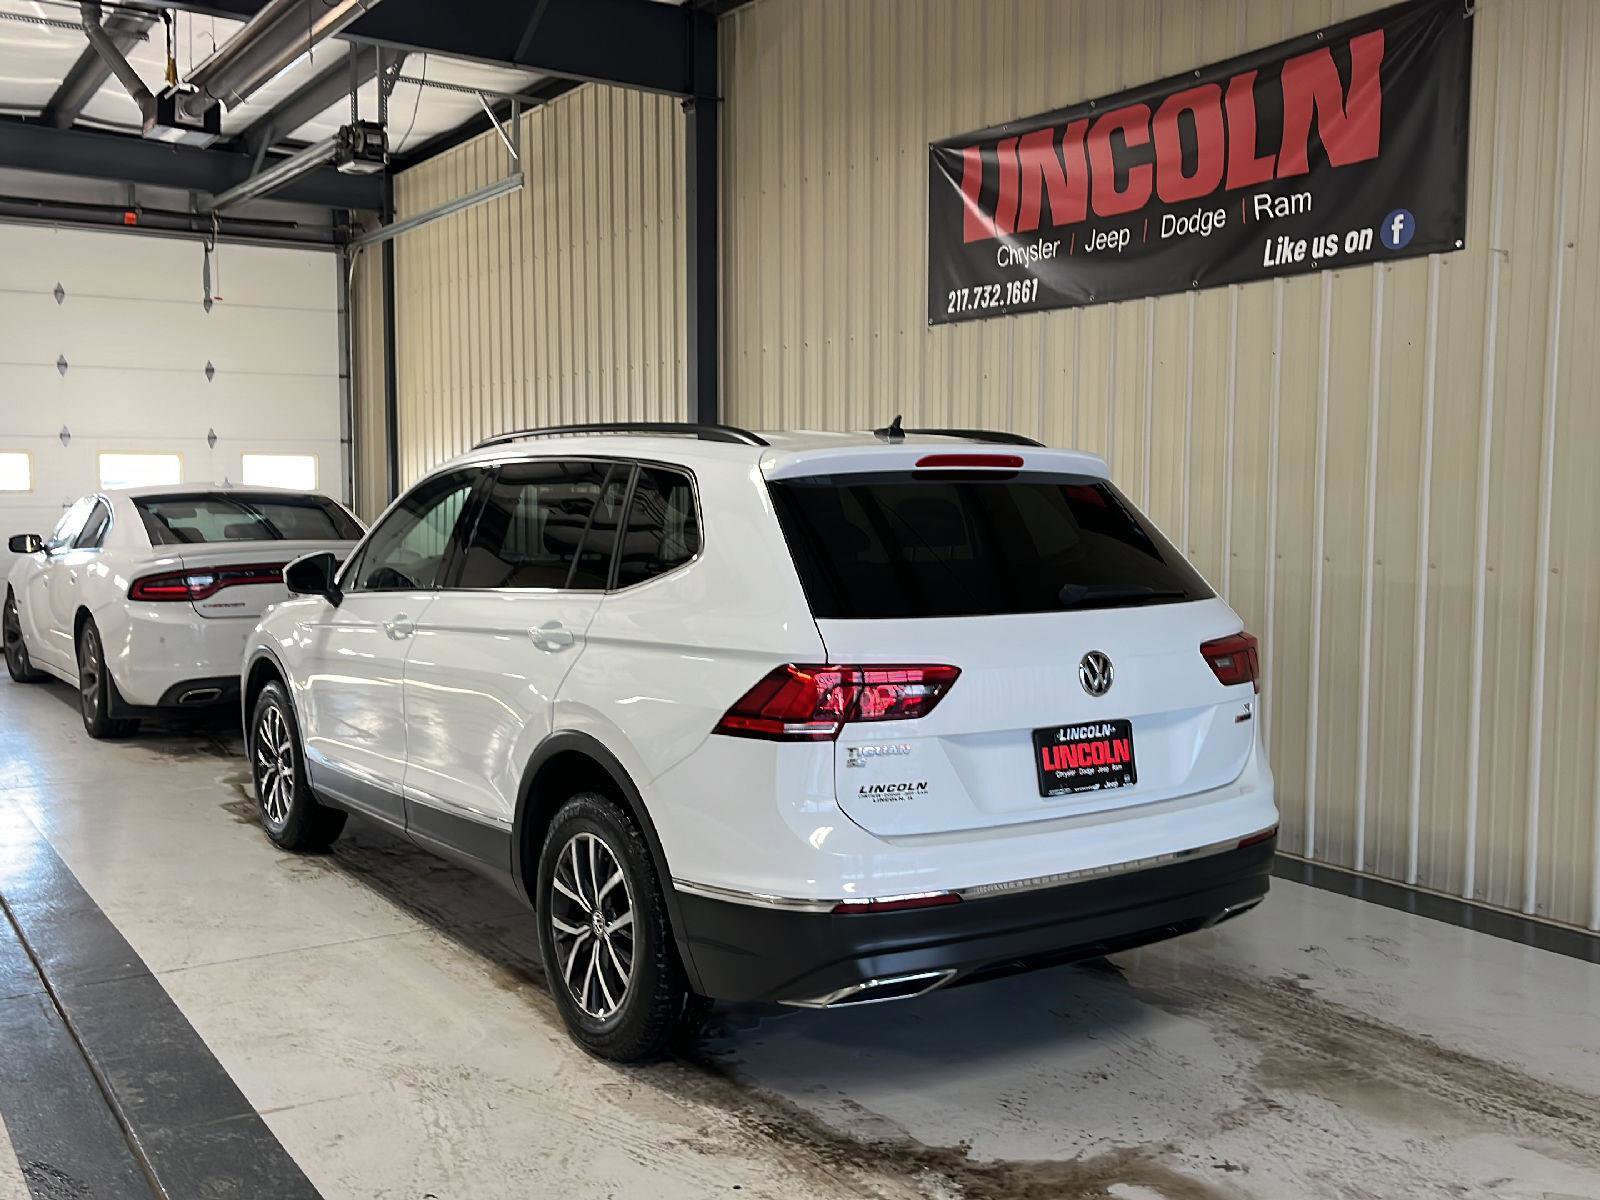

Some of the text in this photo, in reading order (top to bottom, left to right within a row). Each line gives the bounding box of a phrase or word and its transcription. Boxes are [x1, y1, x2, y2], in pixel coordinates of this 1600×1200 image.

[963, 29, 1384, 243] LINCOLN
[997, 191, 1312, 268] Chrysler Jeep Dodge Ram
[1263, 236, 1307, 267] Like
[1312, 234, 1338, 260] us
[1344, 227, 1373, 254] on
[948, 277, 1039, 314] 217.732.1661
[1060, 724, 1111, 741] LINCOLN
[1042, 738, 1130, 771] LINCOLN
[859, 782, 928, 794] LINCOLN
